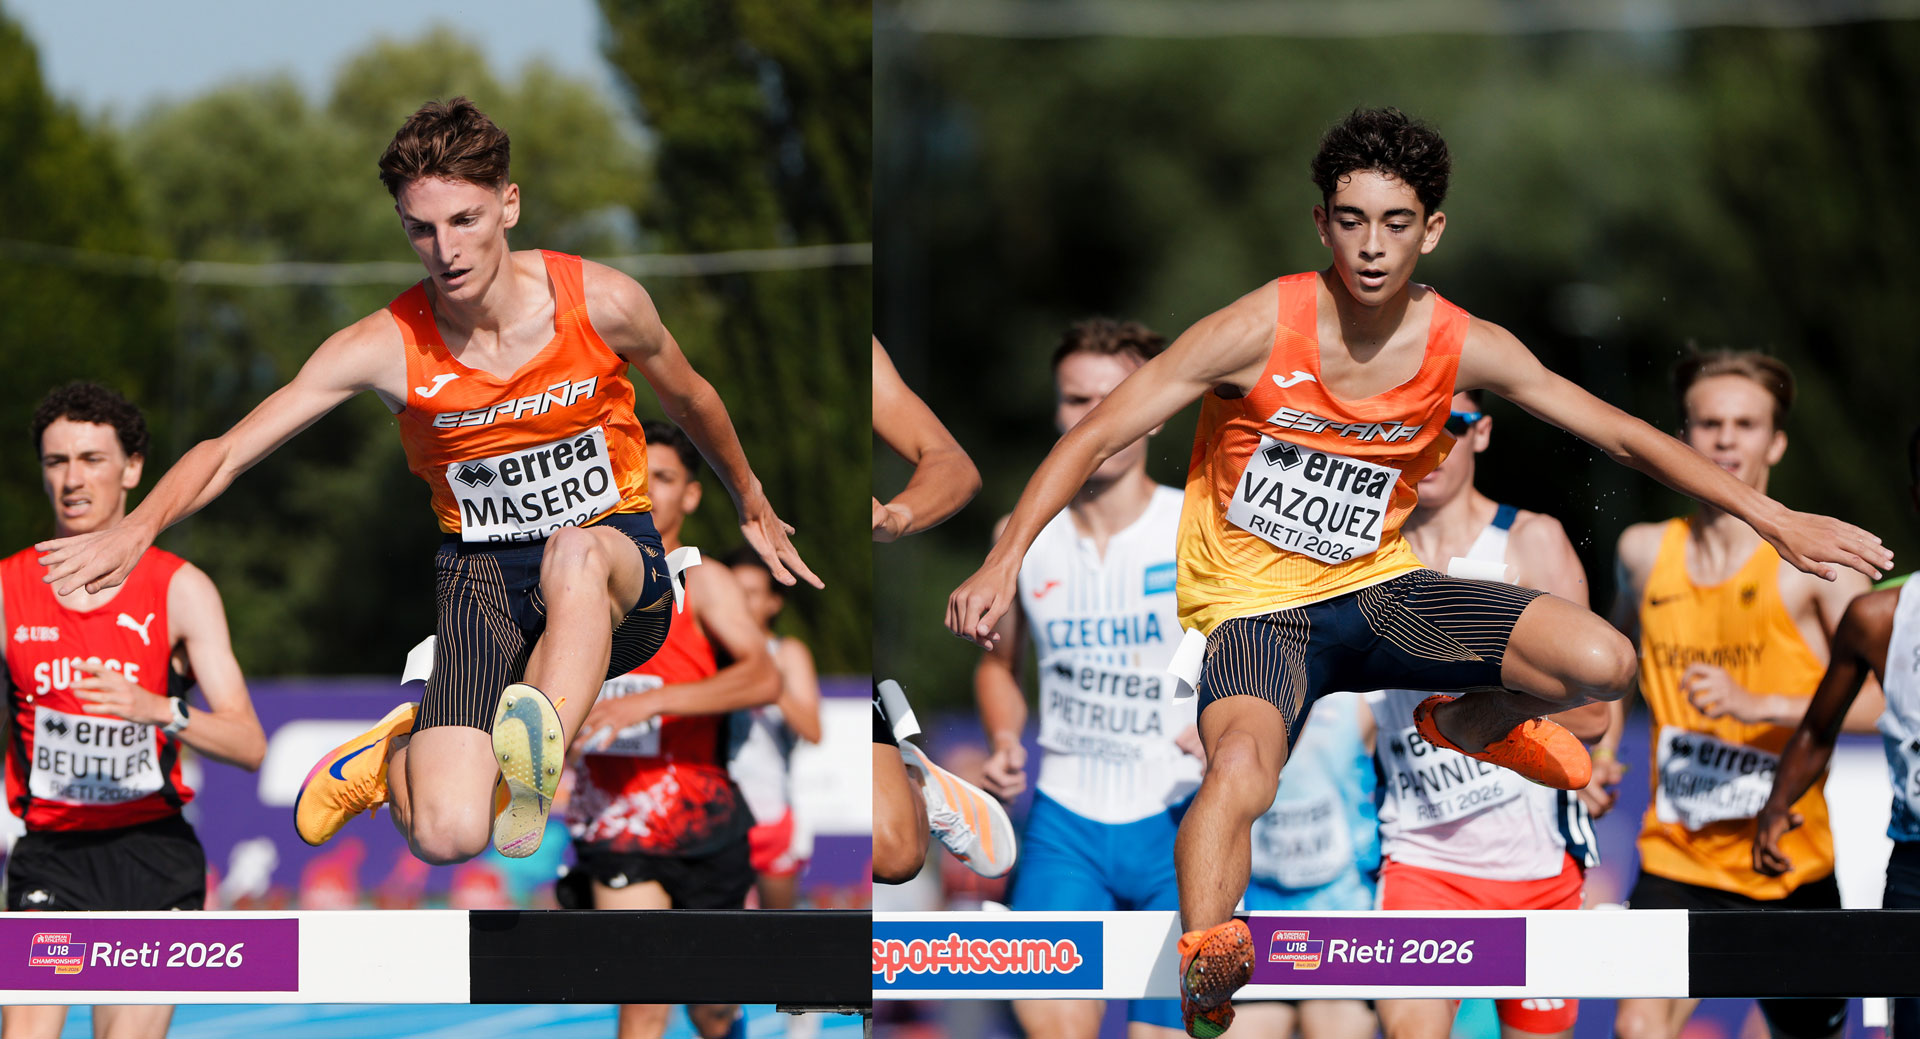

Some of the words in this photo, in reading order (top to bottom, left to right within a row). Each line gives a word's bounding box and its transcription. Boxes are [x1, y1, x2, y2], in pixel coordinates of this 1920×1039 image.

[432, 375, 599, 428] ESPAÑA
[1266, 406, 1424, 443] ESPAÑA
[462, 465, 609, 528] MASERO
[1243, 471, 1381, 542] VAZQUEZ
[1249, 514, 1303, 547] RIETI
[1303, 536, 1355, 562] 2026
[30, 626, 59, 641] UBS
[1047, 612, 1163, 649] CZECHIA
[37, 746, 154, 782] BEUTLER
[1398, 756, 1500, 800] PANNIE
[1456, 781, 1505, 810] 2026
[47, 945, 69, 956] U18
[90, 941, 161, 967] Rieti
[166, 942, 245, 968] 2026
[1286, 942, 1307, 952] U18
[1327, 938, 1395, 964] Rieti
[1399, 939, 1475, 964] 2026
